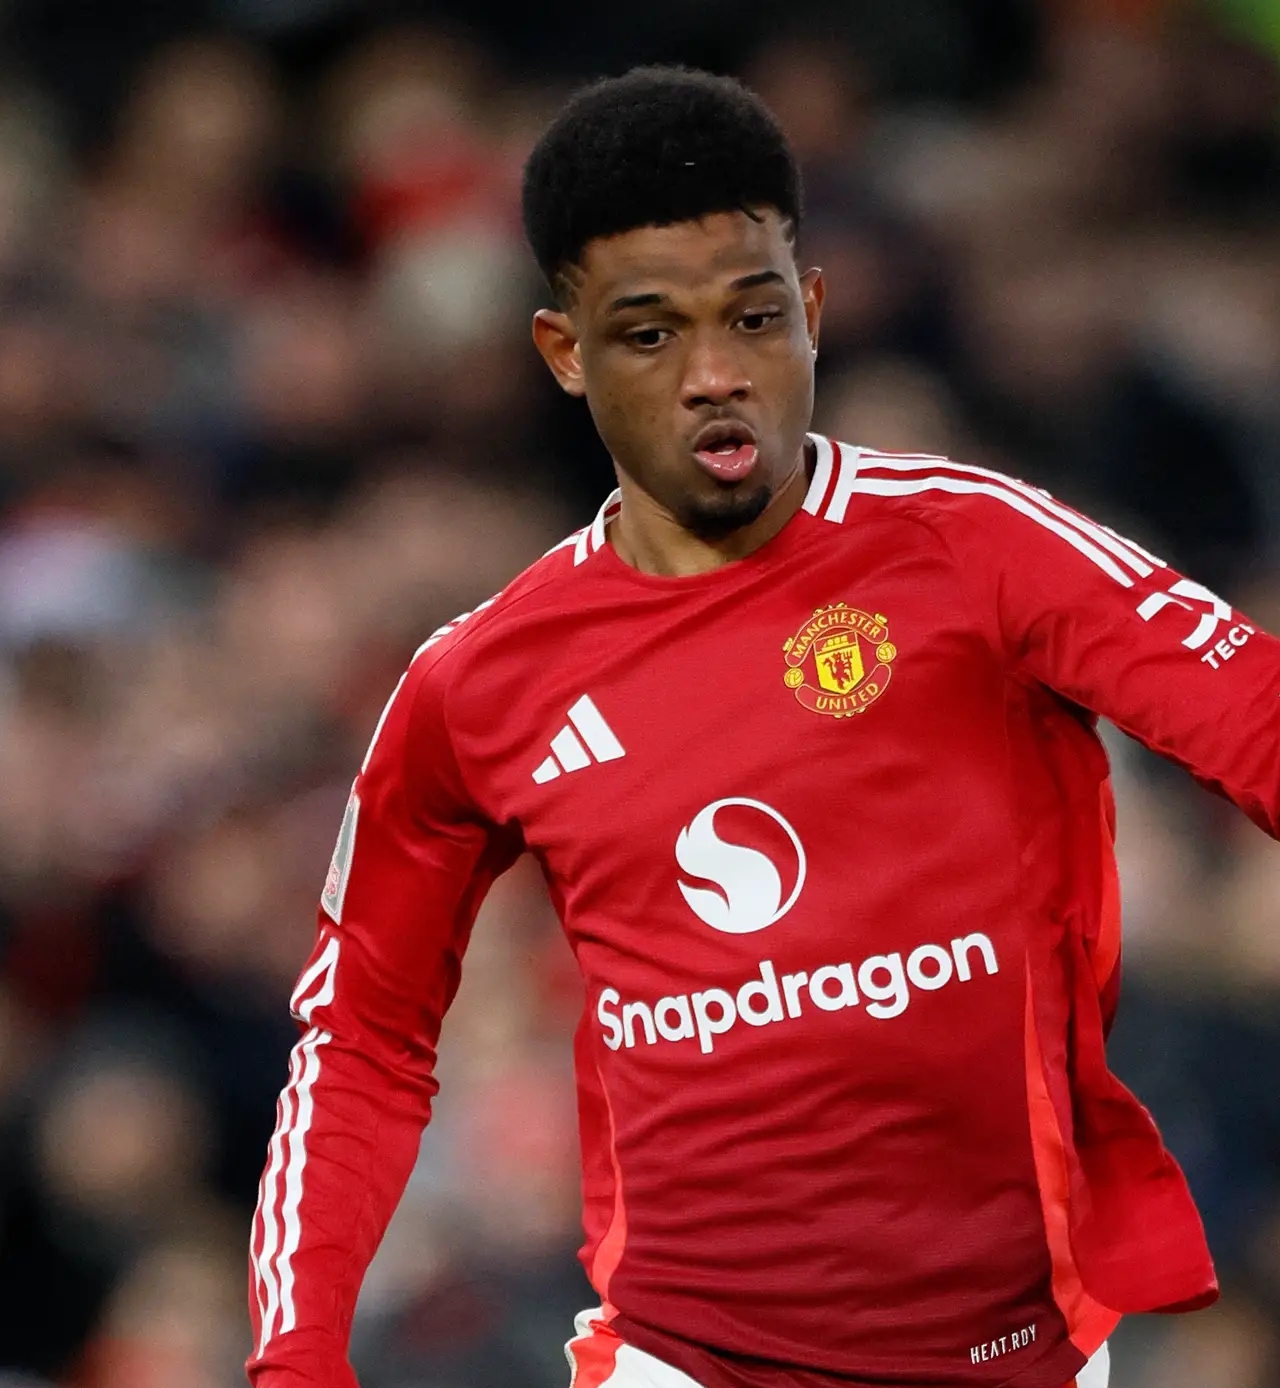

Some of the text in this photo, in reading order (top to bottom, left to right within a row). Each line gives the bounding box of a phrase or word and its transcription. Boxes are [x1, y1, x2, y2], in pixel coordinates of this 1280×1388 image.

[792, 612, 881, 659] MANCHESTER
[816, 683, 879, 710] UNITED
[597, 932, 999, 1054] Snapdragon
[970, 1323, 1036, 1365] HEAT.RDY
